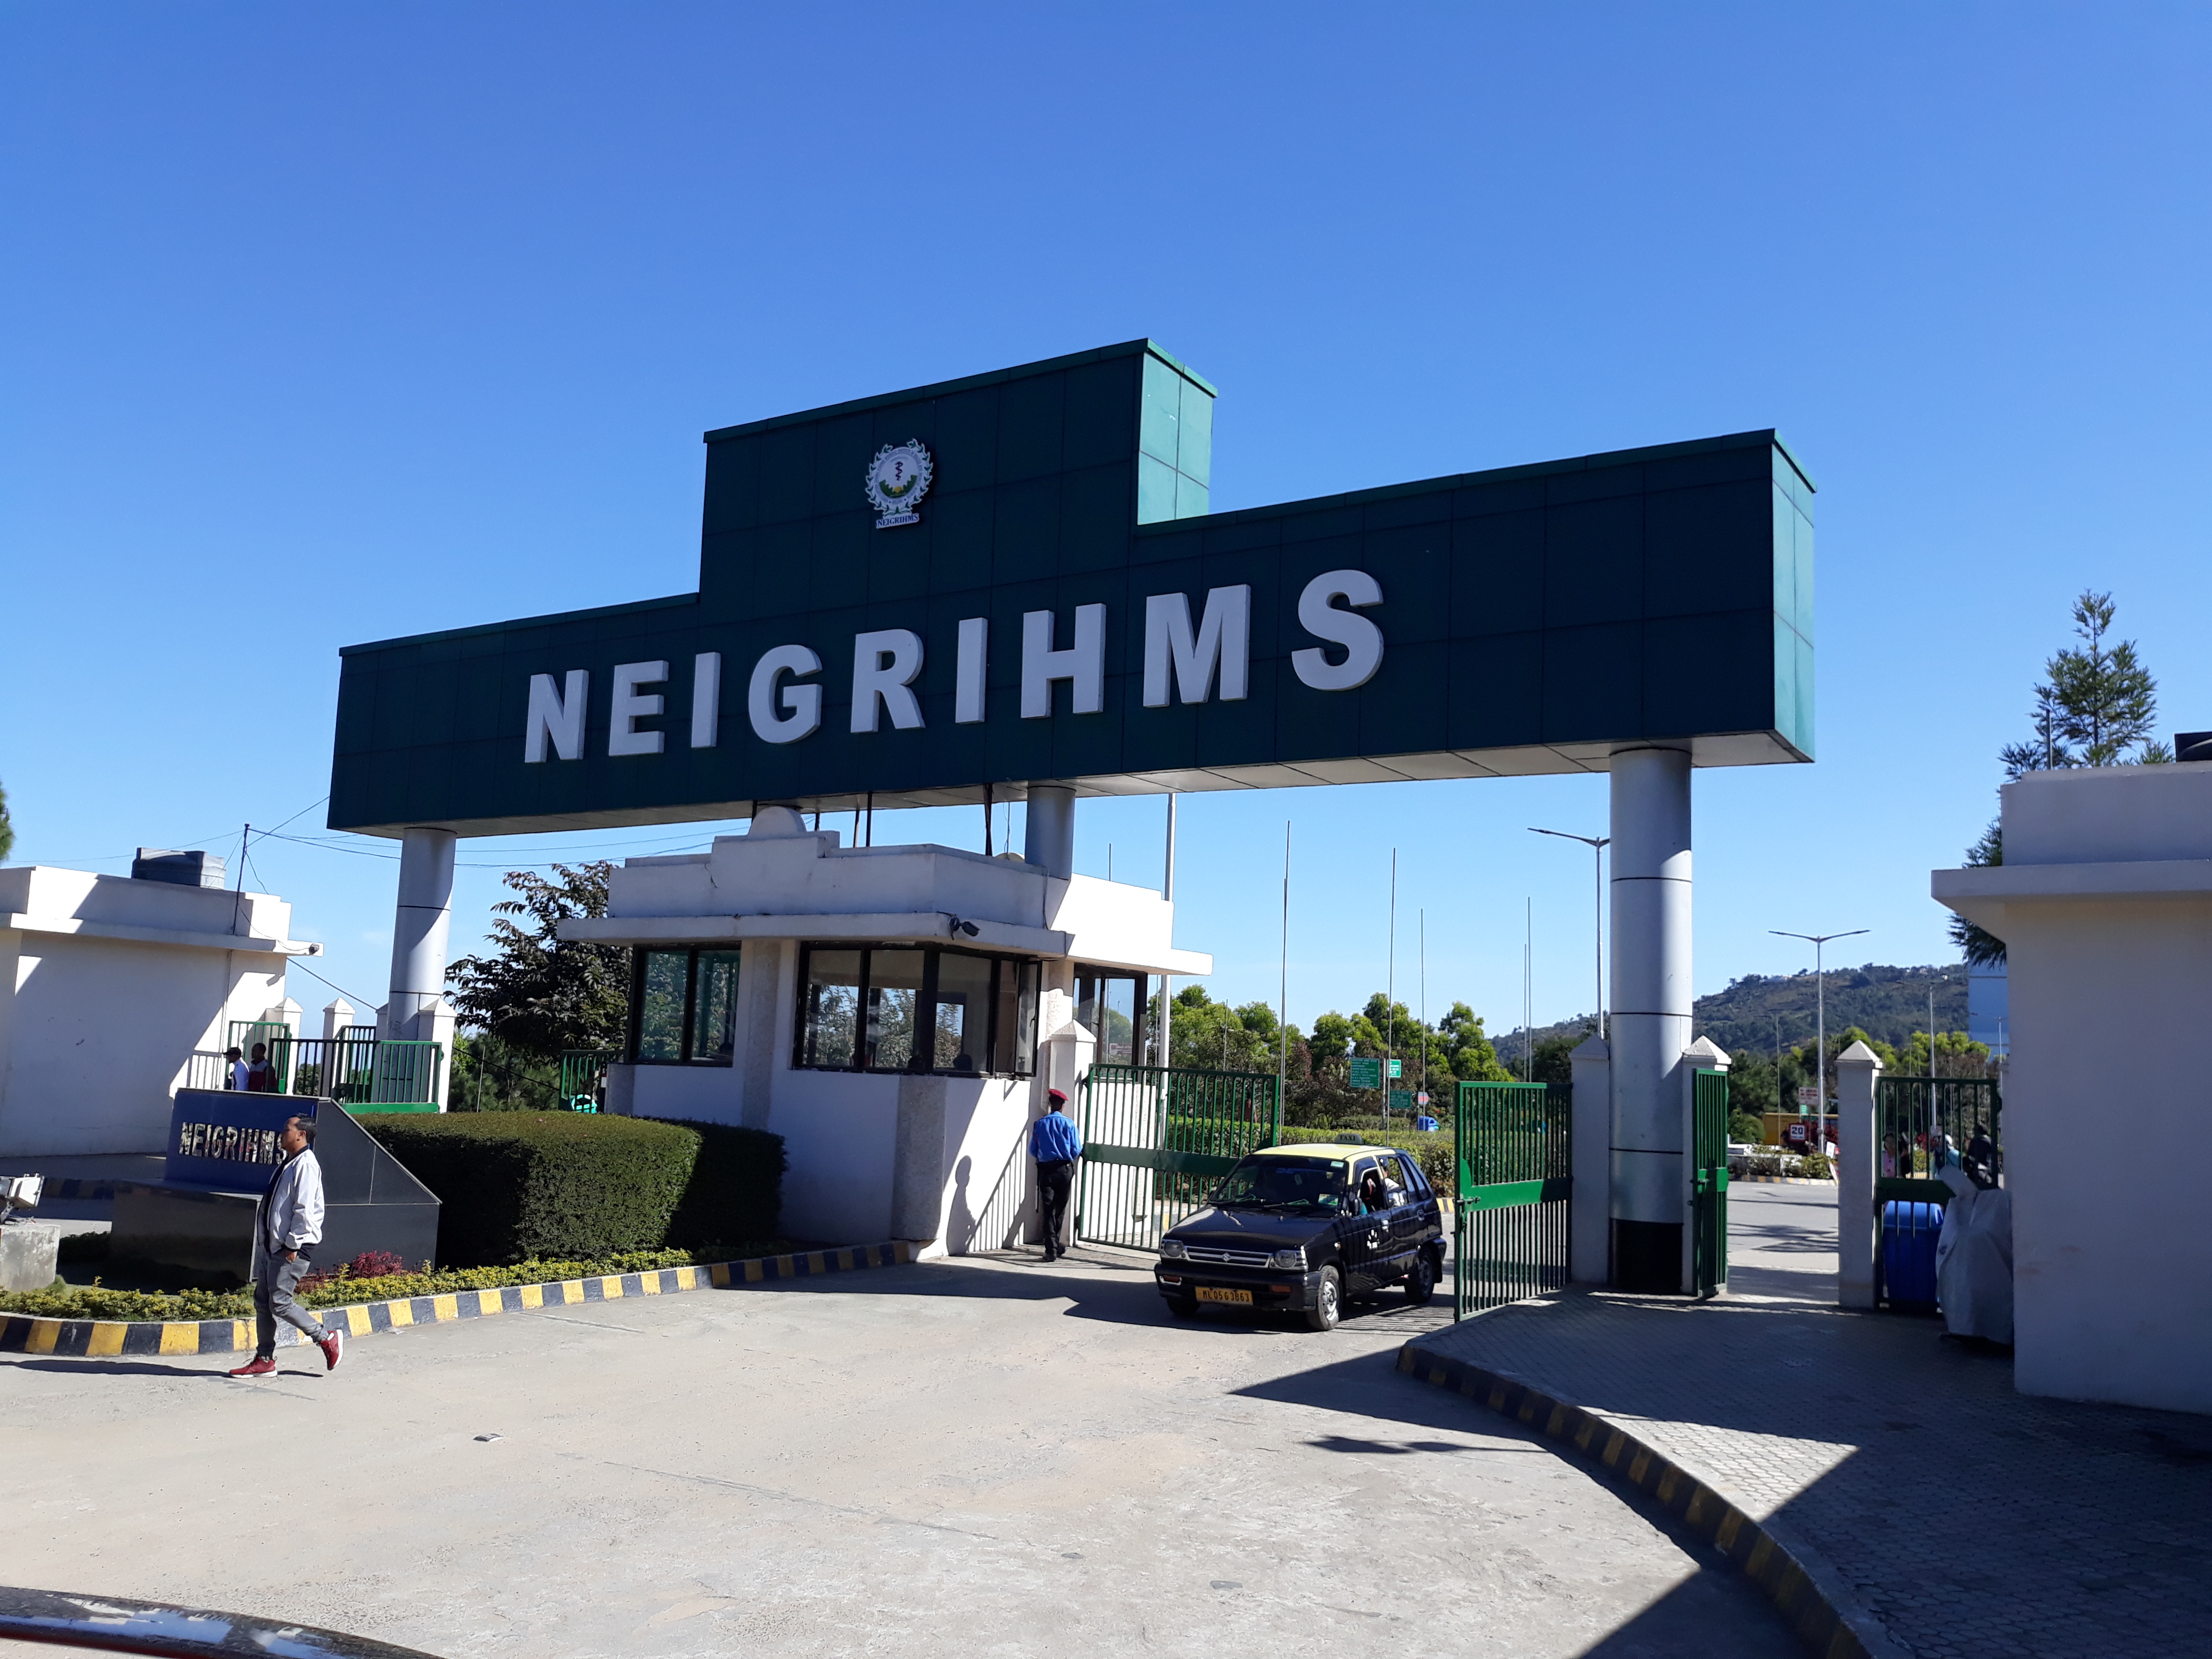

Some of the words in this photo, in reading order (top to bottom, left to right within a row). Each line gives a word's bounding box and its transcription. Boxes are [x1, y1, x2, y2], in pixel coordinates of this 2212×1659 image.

[877, 514, 919, 528] NEIGRIHMS
[524, 569, 1384, 764] NEIGRIHMS
[1791, 1127, 1804, 1135] 20
